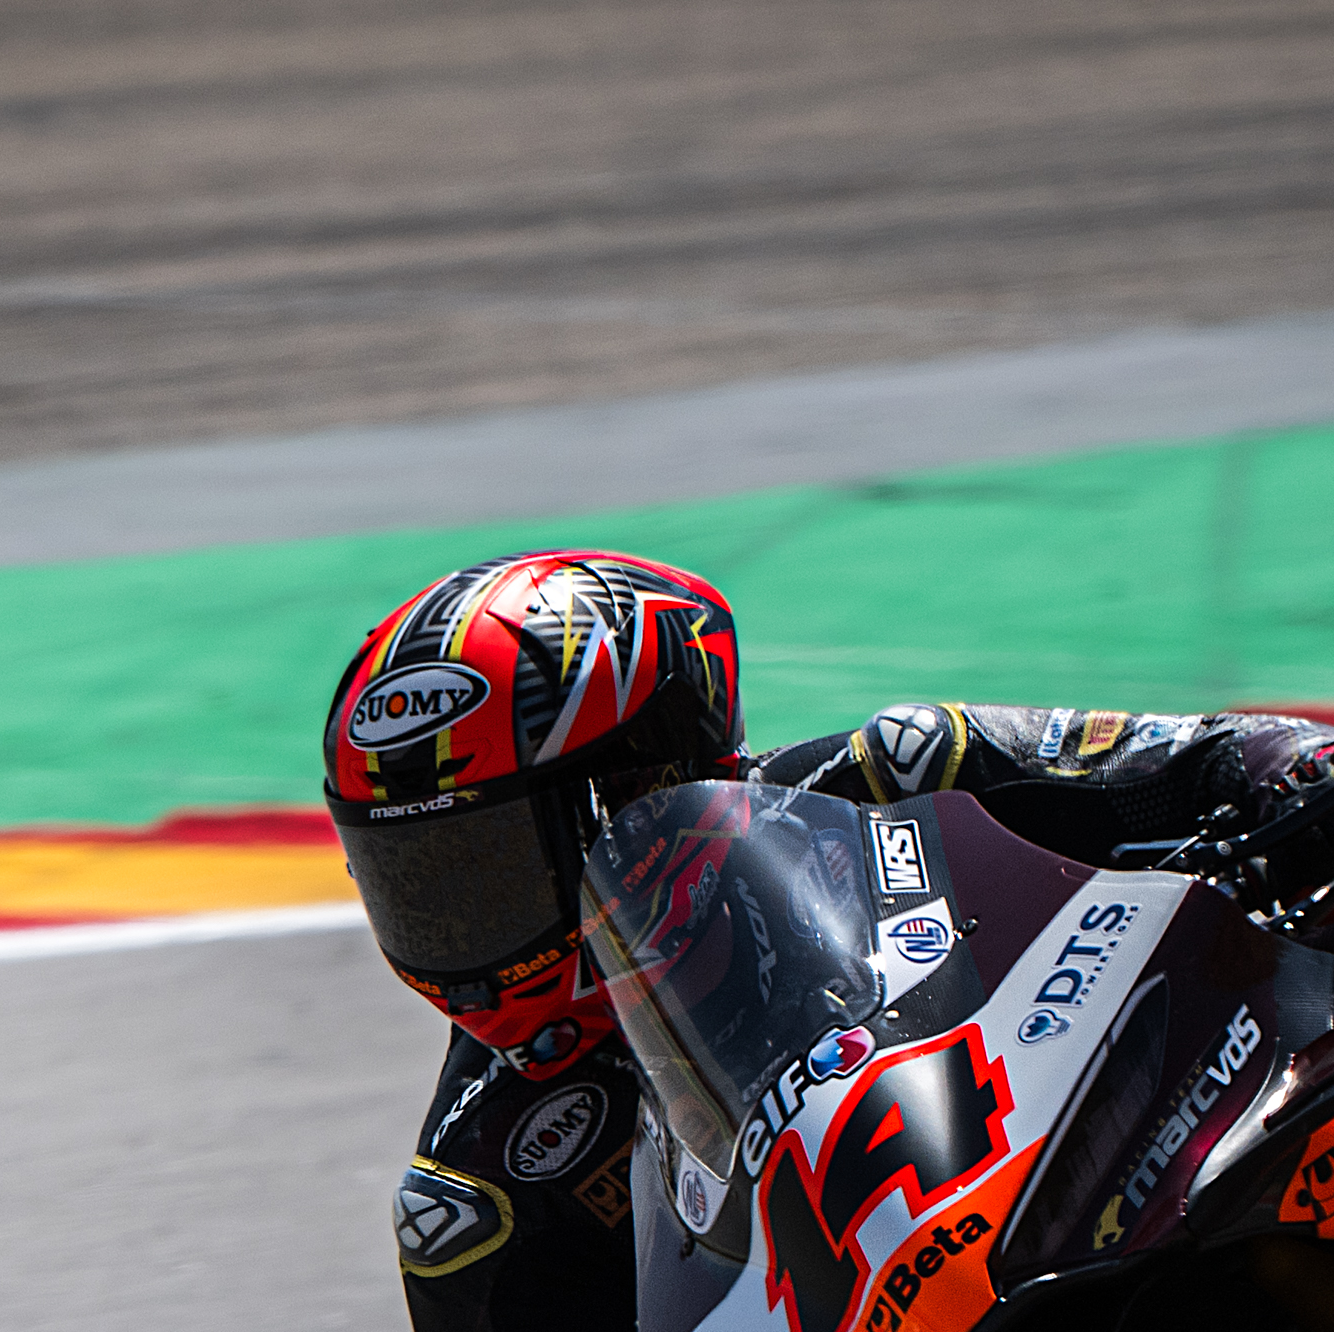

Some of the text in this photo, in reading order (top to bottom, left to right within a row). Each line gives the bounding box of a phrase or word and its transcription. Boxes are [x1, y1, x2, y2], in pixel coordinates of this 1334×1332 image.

[355, 688, 470, 726] SUOMY
[877, 825, 923, 890] WRS
[1118, 905, 1139, 932] GAS
[513, 949, 562, 979] Beta
[1033, 903, 1126, 1004] DTS
[515, 1094, 596, 1171] SUOMY
[883, 1213, 993, 1315] Beta
